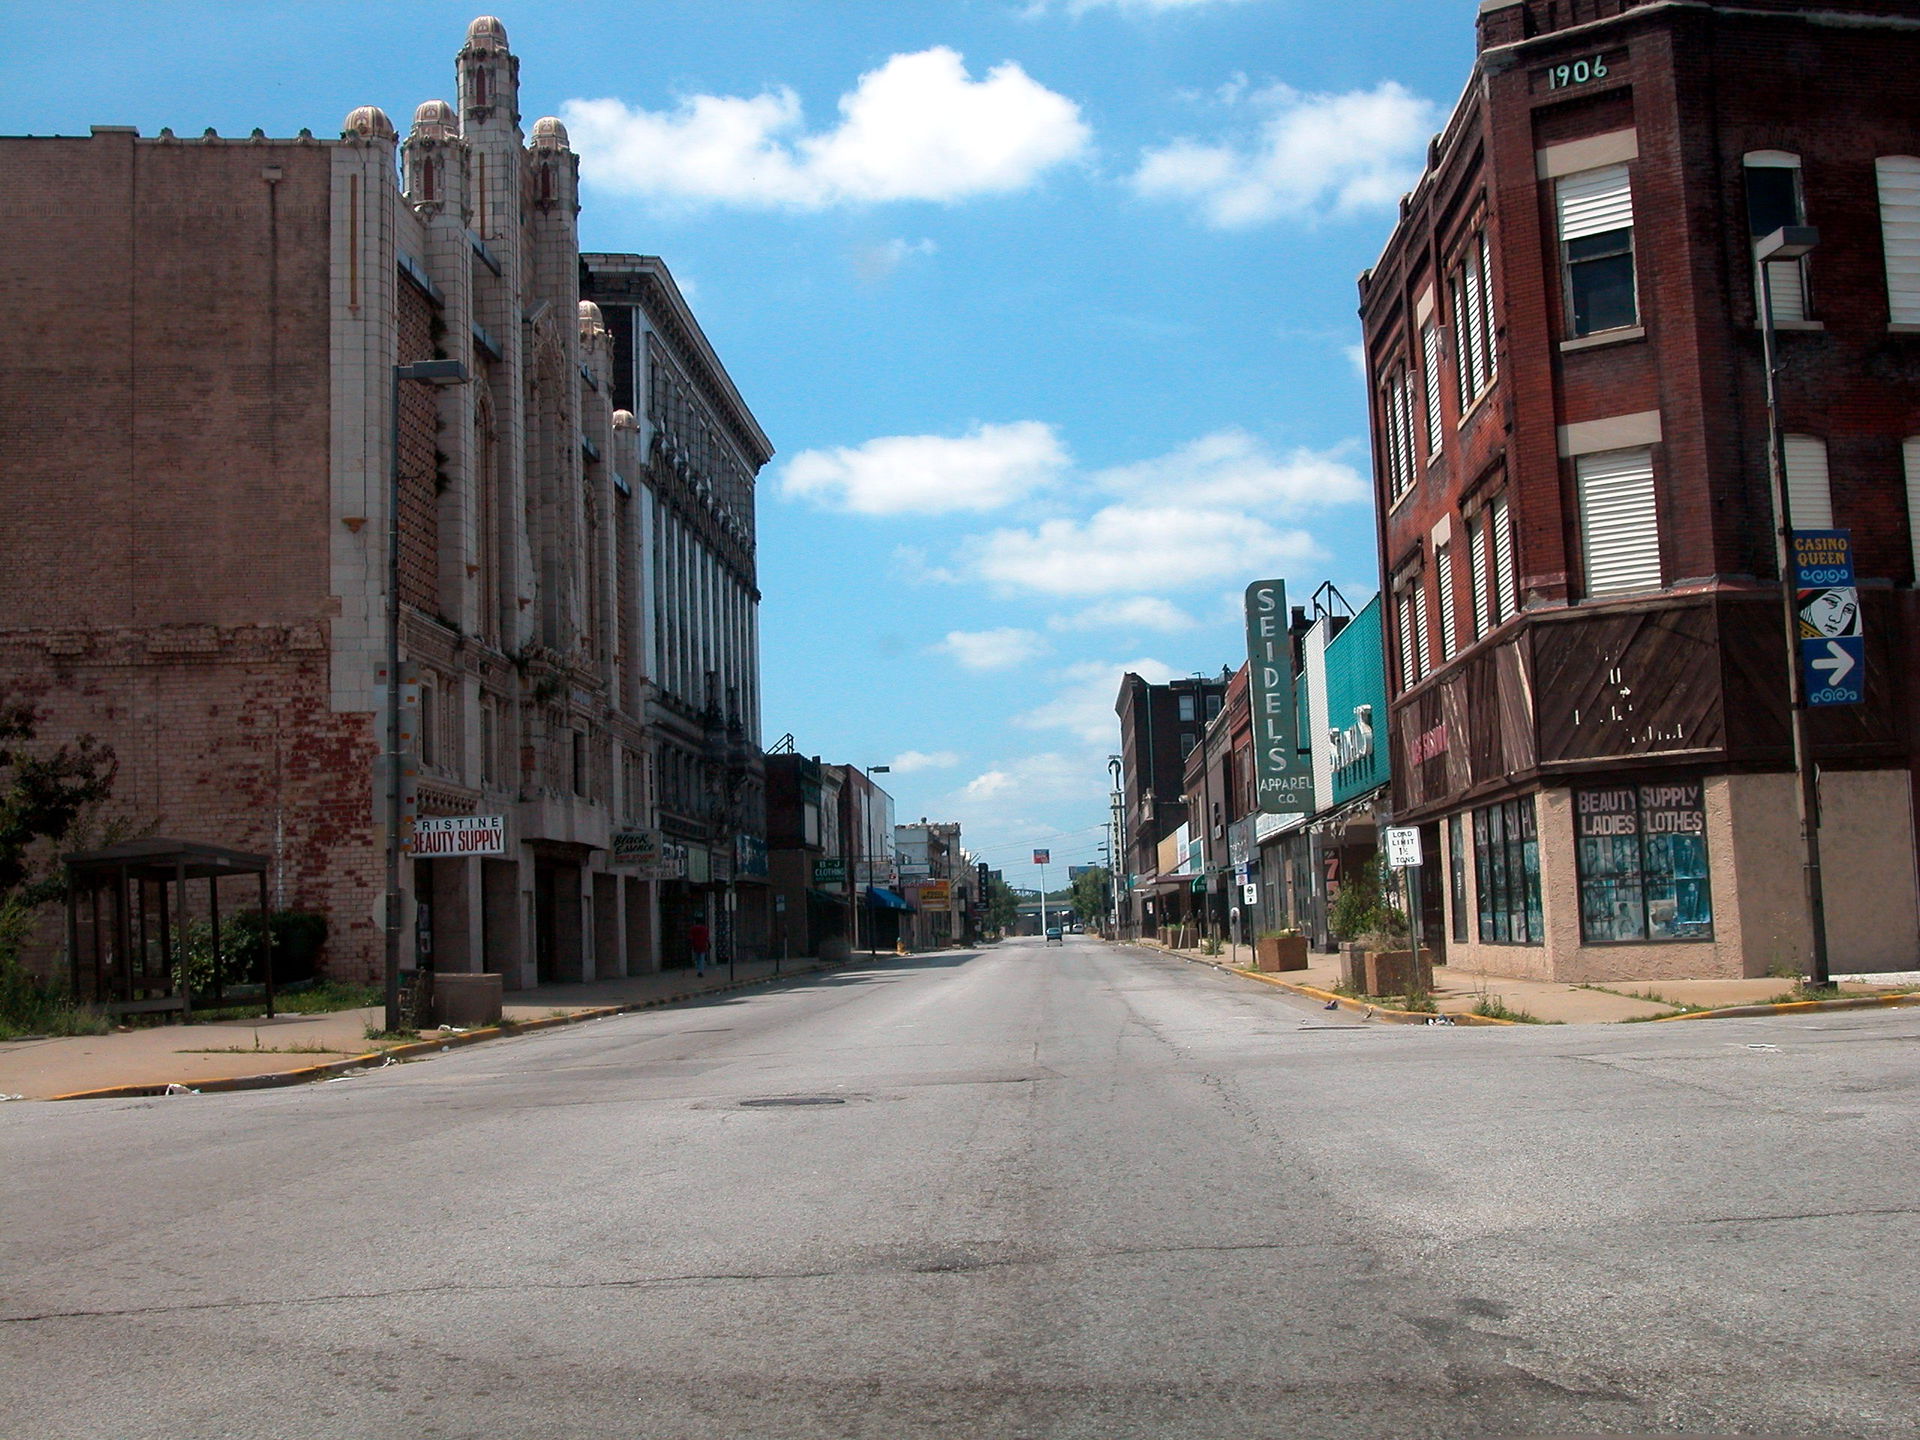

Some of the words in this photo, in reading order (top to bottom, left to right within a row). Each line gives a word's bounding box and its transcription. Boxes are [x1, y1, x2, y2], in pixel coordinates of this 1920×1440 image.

[1548, 54, 1608, 90] 1906
[1794, 537, 1848, 551] CASINO
[1797, 551, 1846, 567] QUEEN
[1260, 776, 1313, 792] APPAREL
[1578, 790, 1637, 814] BEAUTY
[1639, 786, 1698, 808] SUPPLY
[411, 831, 455, 854] BEAUTY
[458, 829, 502, 852] SUPPLY
[1392, 830, 1413, 838] LOAD
[1392, 838, 1414, 846] LIMIT
[815, 868, 845, 877] CLOTHING
